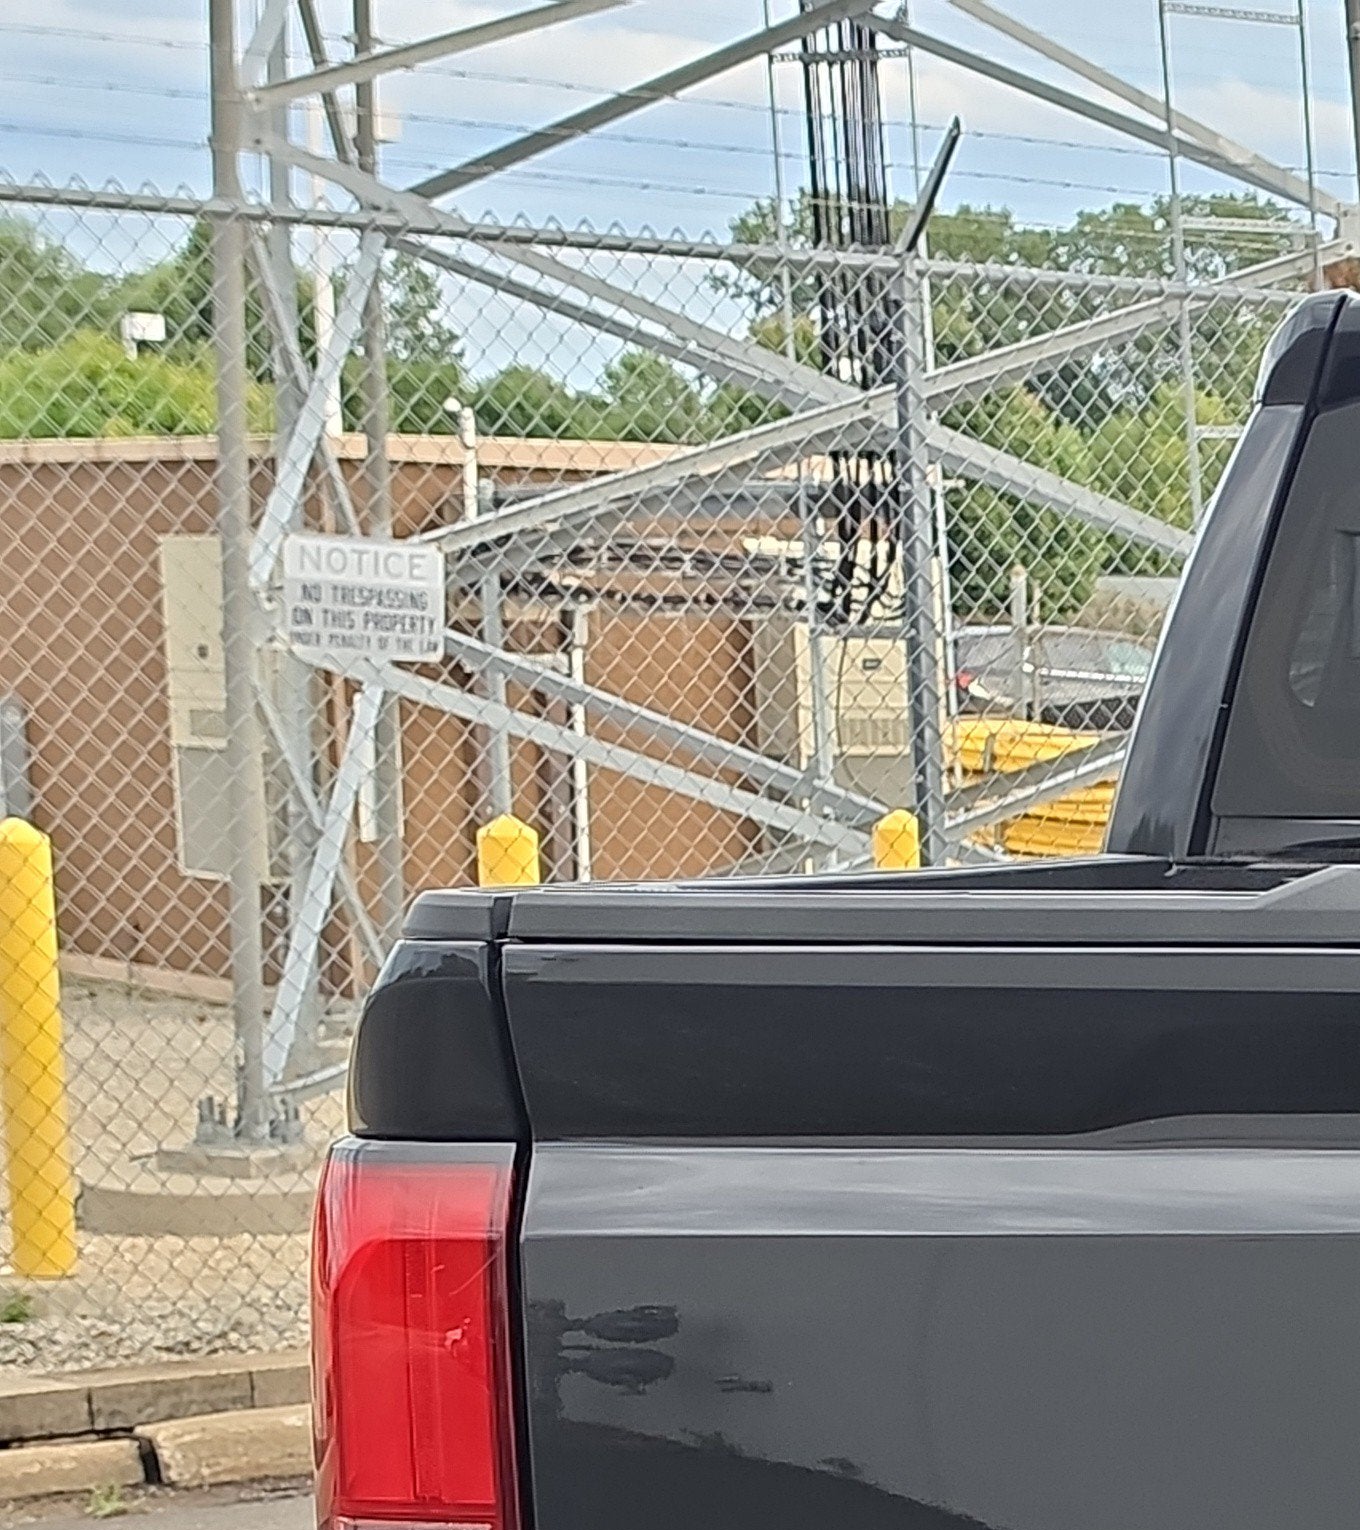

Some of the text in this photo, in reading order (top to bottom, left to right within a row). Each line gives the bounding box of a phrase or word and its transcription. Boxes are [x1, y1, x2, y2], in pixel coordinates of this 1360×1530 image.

[300, 546, 426, 580] NOTICE
[302, 584, 429, 611] NO TRESPASSING
[291, 607, 435, 635] ON THIS PROPERTY
